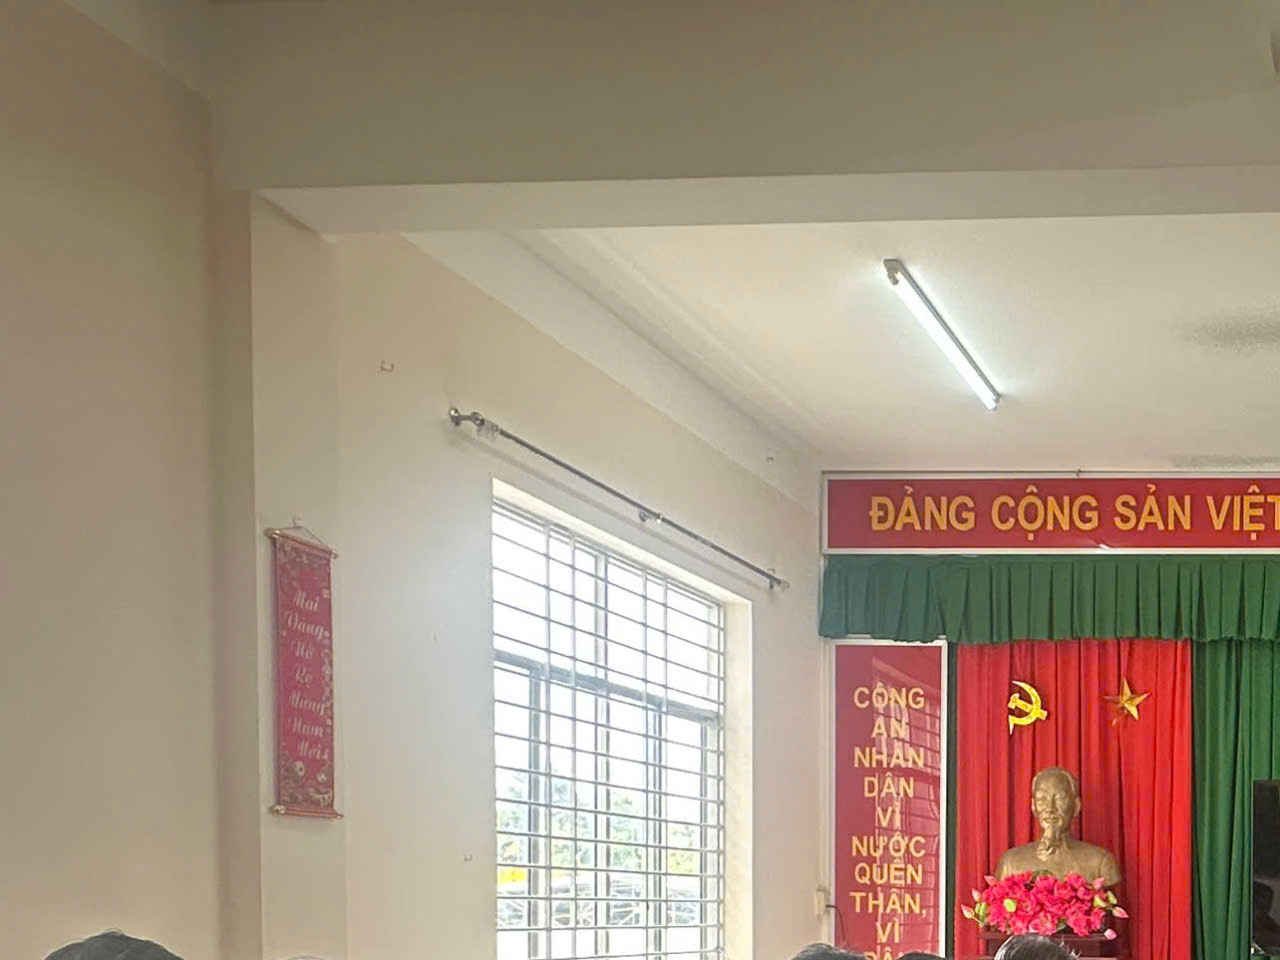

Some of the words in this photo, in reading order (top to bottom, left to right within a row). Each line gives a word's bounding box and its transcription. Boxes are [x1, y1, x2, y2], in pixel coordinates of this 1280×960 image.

[868, 485, 976, 532] ĐẢNG
[991, 484, 1099, 541] CỘNG
[1113, 483, 1191, 531] SẢN
[853, 681, 925, 709] CÔNG
[871, 717, 906, 739] AN
[853, 741, 925, 769] NHÂN
[864, 771, 914, 798] DÂN
[876, 801, 901, 828] VÌ
[851, 831, 927, 858] NƯỚC
[854, 858, 923, 885] QUÊN
[849, 888, 927, 918] THÂN,
[875, 917, 900, 944] VÌ
